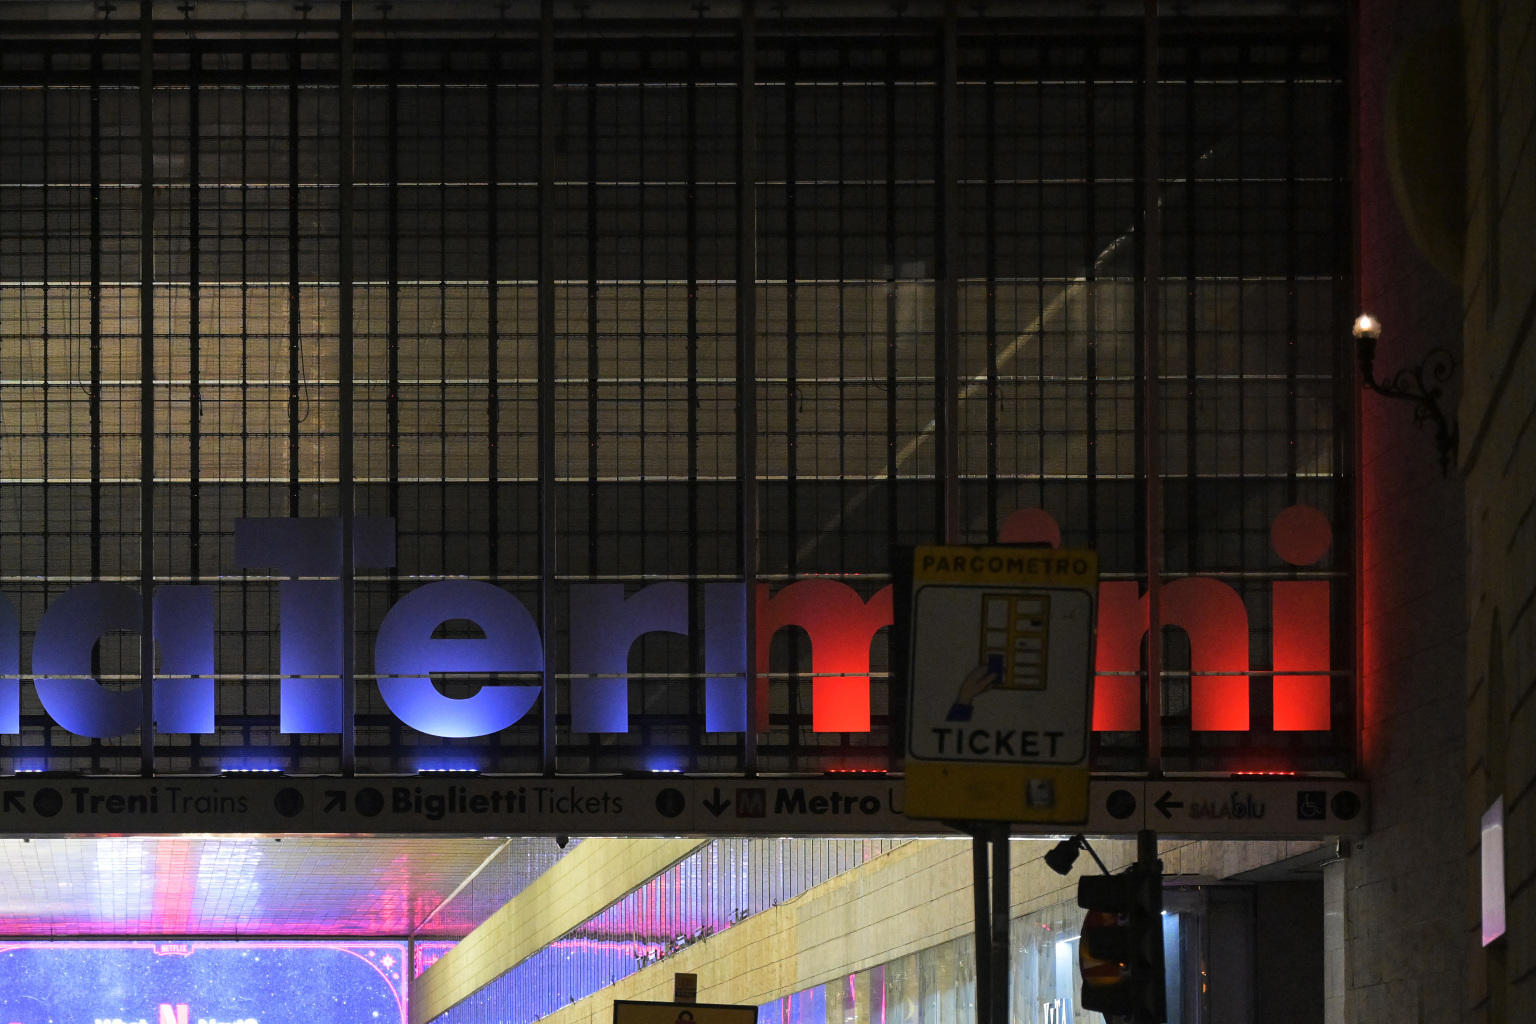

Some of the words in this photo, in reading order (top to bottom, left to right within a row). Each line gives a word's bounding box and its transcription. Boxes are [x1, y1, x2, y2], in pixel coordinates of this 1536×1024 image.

[922, 555, 1088, 576] PARCOMETRO
[932, 728, 1065, 758] TICKET
[71, 787, 158, 815] Treni
[165, 787, 248, 815] Trains
[392, 786, 527, 820] Biglietti
[532, 787, 623, 815] Tickets
[774, 787, 880, 815] Metro
